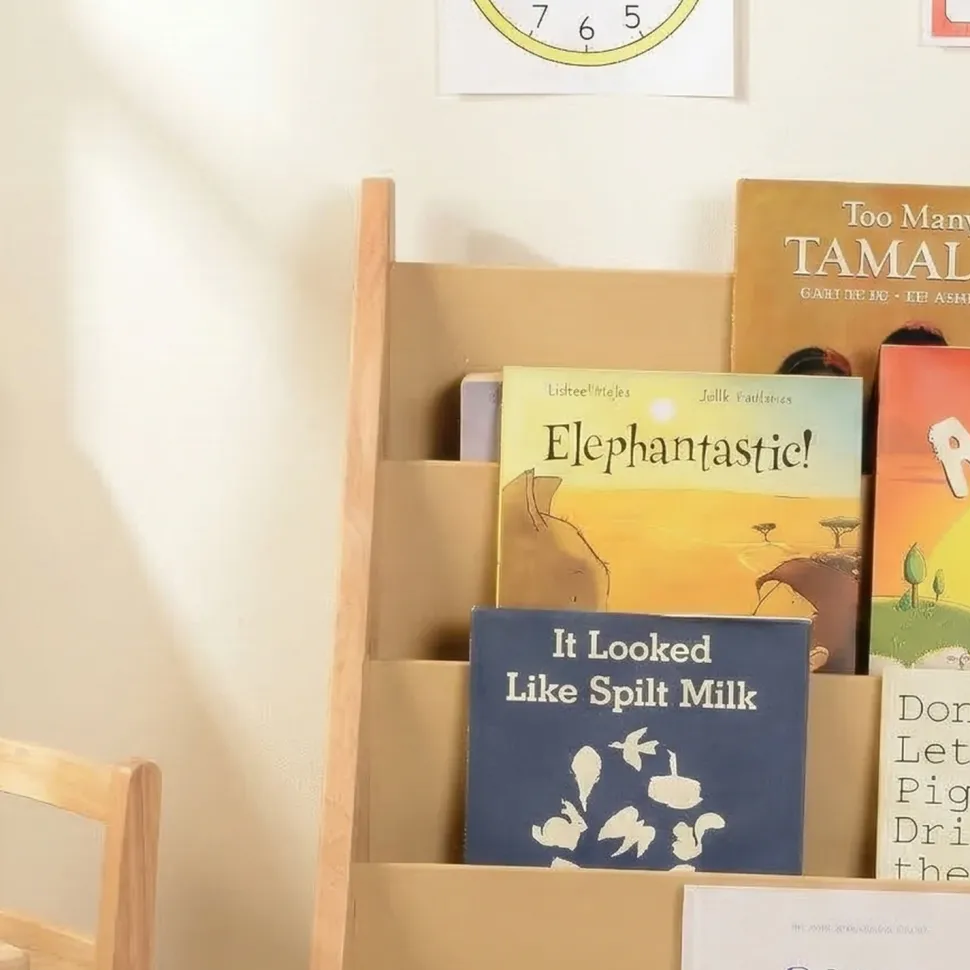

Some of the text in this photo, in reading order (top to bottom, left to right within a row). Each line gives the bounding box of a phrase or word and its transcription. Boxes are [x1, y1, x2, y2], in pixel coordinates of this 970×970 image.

[532, 4, 548, 29] 7
[579, 15, 595, 41] 6
[624, 4, 641, 29] 5
[842, 201, 892, 228] Too
[543, 421, 813, 475] Elephantastic!
[552, 628, 712, 663] It Looked
[506, 671, 757, 713] Like Spilt Milk
[894, 735, 970, 765] Let
[894, 857, 970, 882] the
